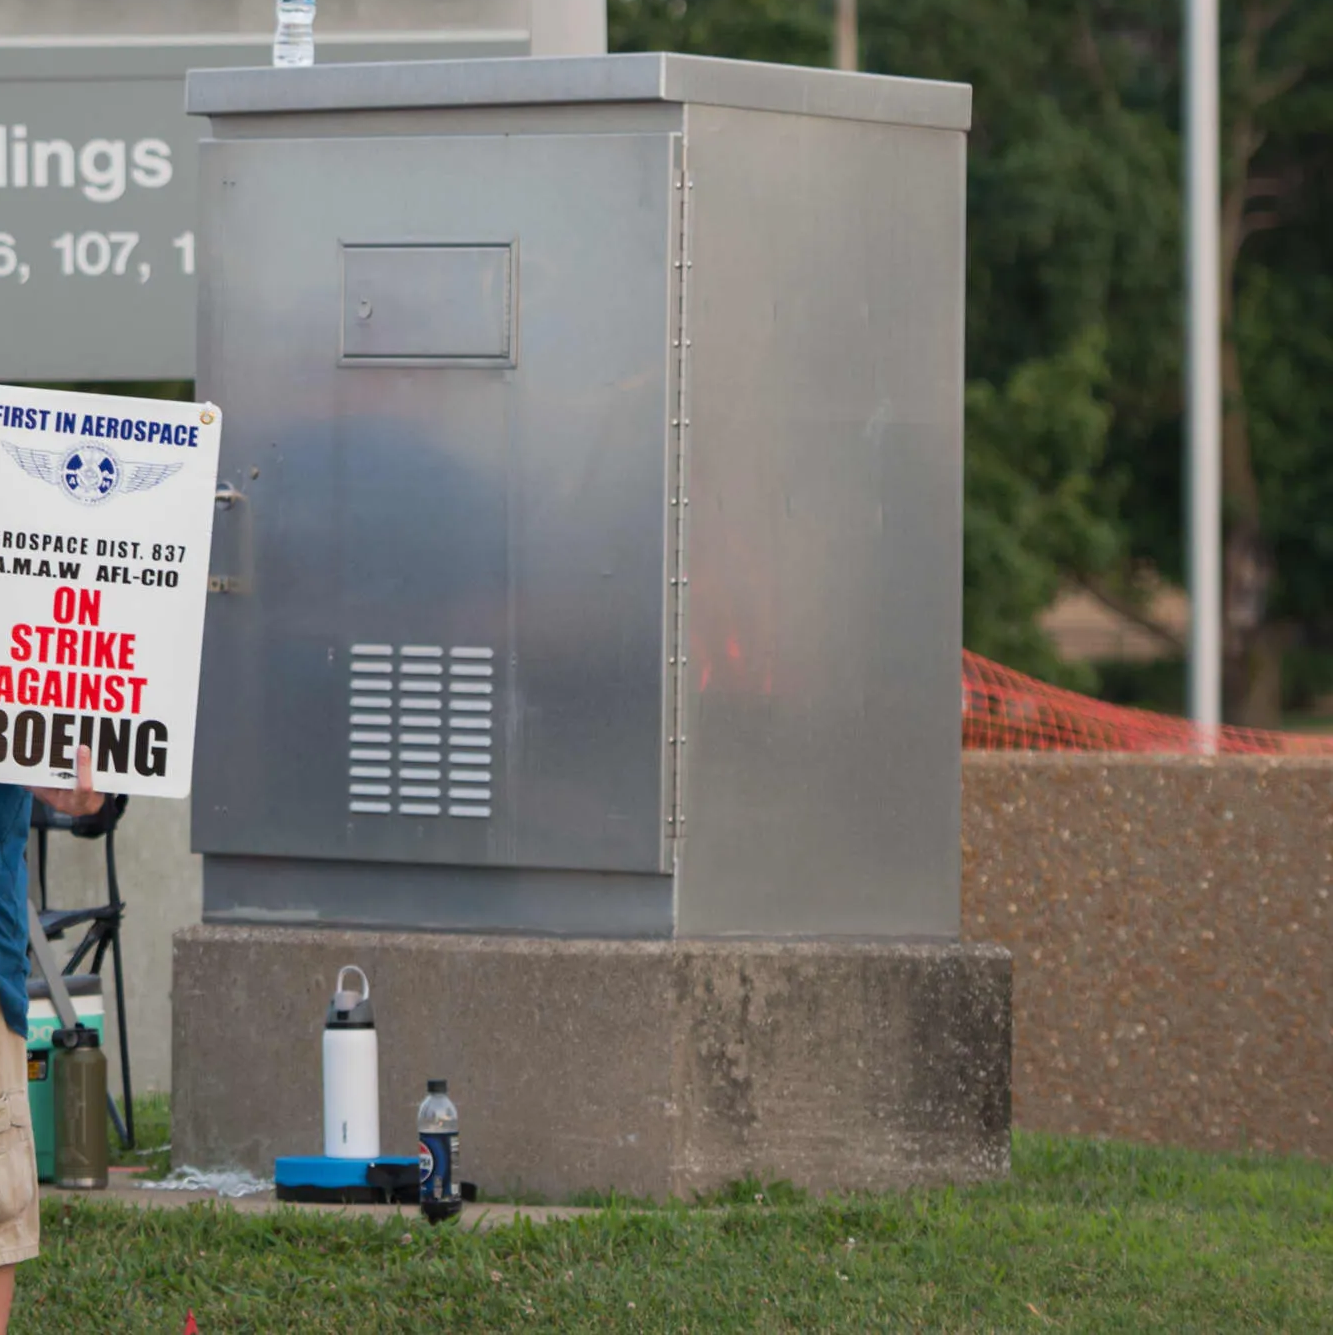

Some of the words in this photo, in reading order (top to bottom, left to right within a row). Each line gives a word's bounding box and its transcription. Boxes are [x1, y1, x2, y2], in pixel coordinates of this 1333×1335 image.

[52, 231, 151, 284] 107,
[55, 412, 75, 434] IN
[80, 415, 199, 448] AEROSPACE
[97, 539, 144, 560] DIST.
[152, 544, 187, 563] 837
[96, 565, 178, 588] AFL-CIO
[53, 587, 101, 626] ON
[10, 624, 136, 671] STRIKE
